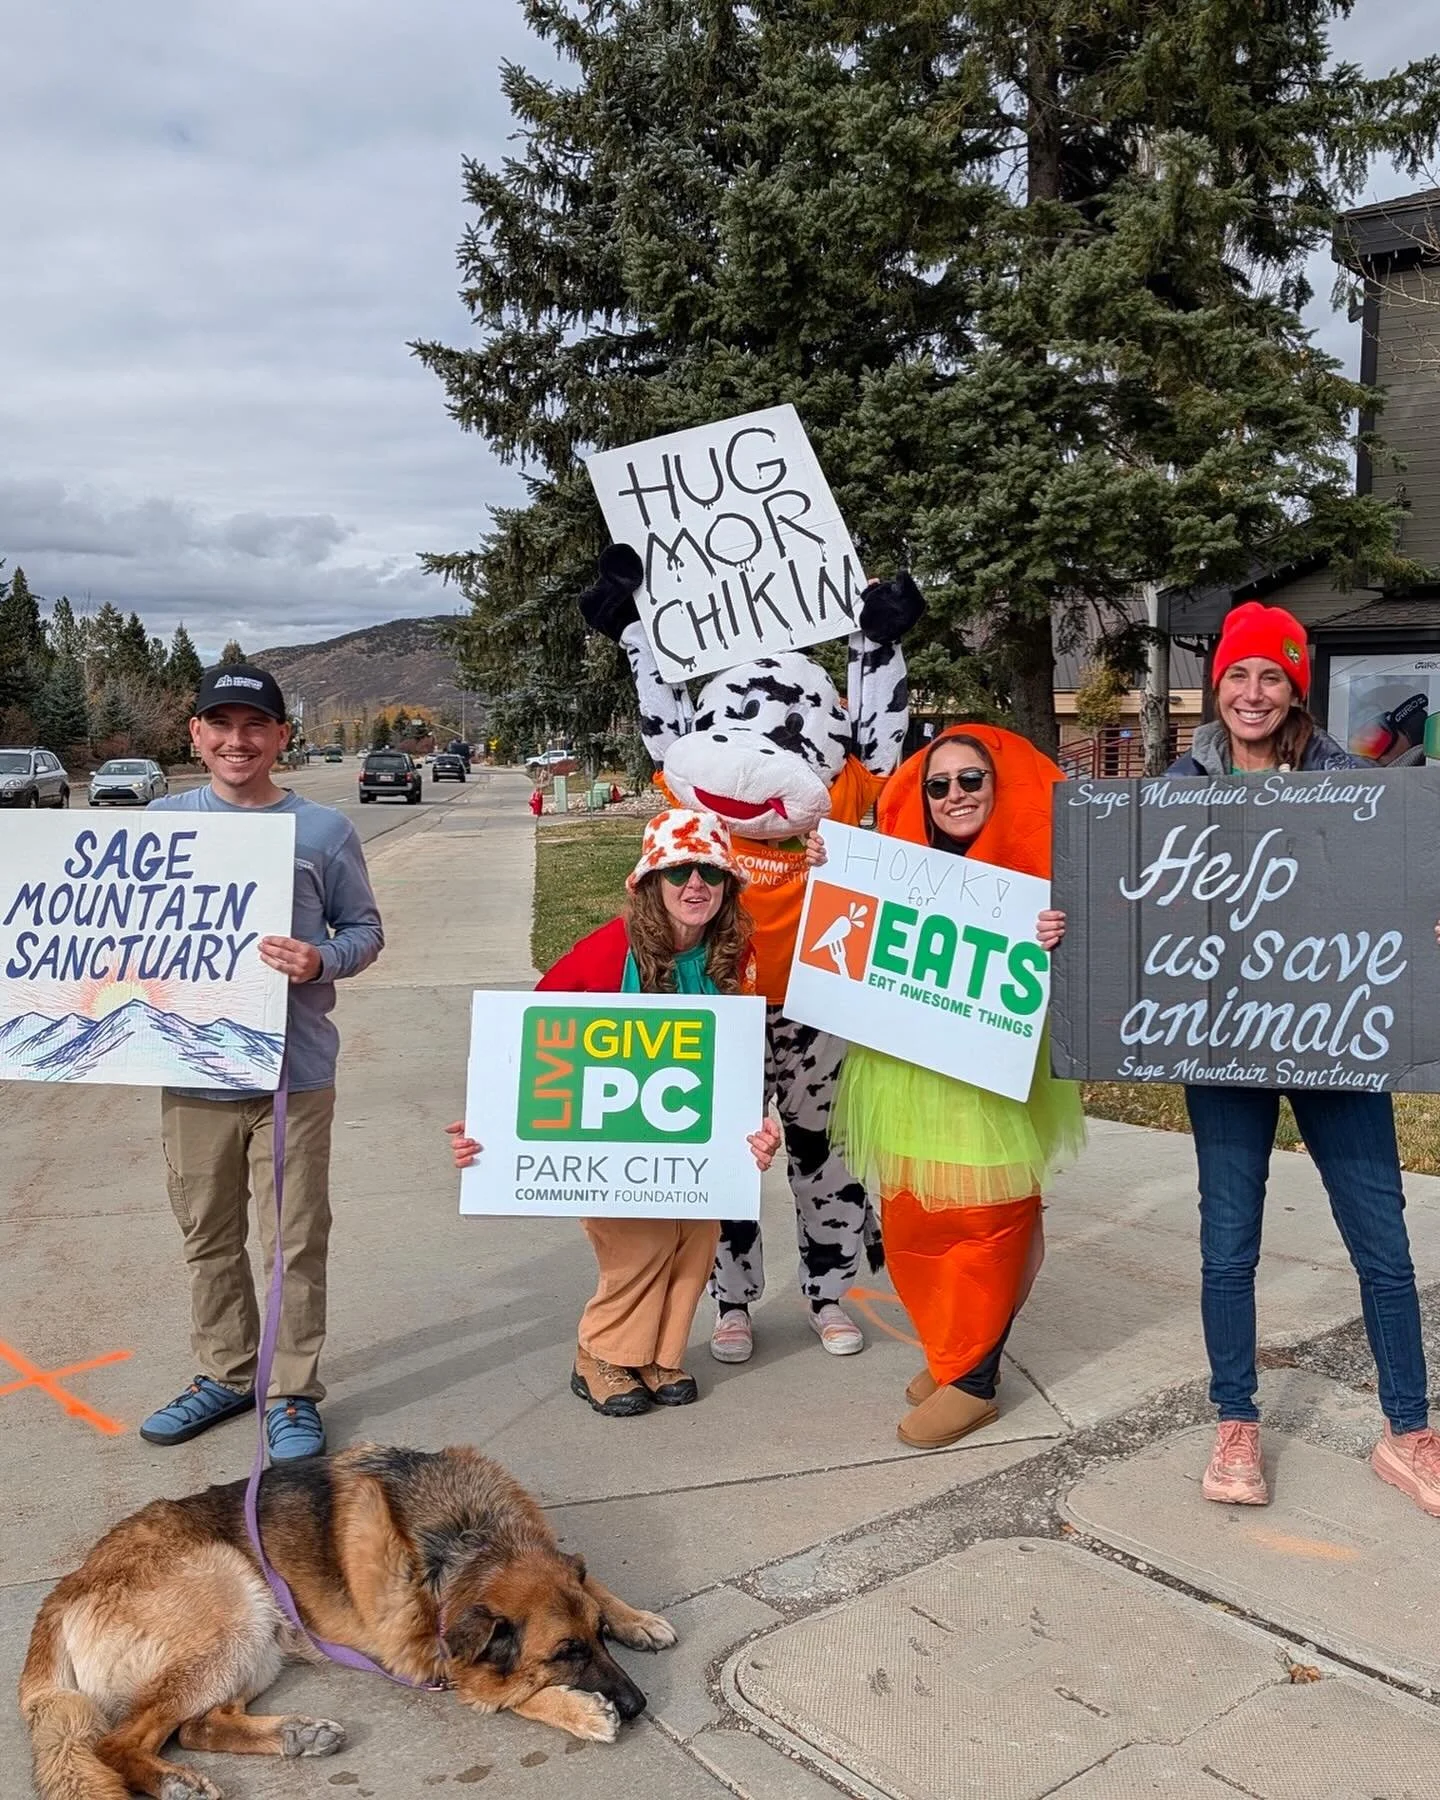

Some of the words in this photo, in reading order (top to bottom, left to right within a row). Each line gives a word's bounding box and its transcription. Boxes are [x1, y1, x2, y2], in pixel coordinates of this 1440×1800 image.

[618, 427, 787, 528] HUG
[646, 490, 827, 605] MOR
[652, 554, 862, 673] CHIKIN
[1068, 783, 1131, 819] Sage
[1139, 780, 1248, 808] Mountain
[1254, 775, 1386, 821] Sanctuary
[64, 829, 198, 881] SAGE
[761, 848, 786, 861] PARK
[788, 851, 806, 862] CIT
[844, 832, 1011, 918] HONK!
[1119, 824, 1299, 932] Help
[3, 881, 258, 932] MOUNTAIN
[907, 886, 937, 907] for
[5, 931, 259, 983] SANCTUARY
[871, 899, 1049, 1016] EATS
[1144, 933, 1226, 981] us
[1240, 930, 1408, 985] save
[867, 972, 897, 993] EAT
[899, 982, 972, 1018] AWESOME
[978, 1007, 1034, 1038] THINGS
[1119, 984, 1395, 1062] animals
[582, 1018, 703, 1061] GIVE
[532, 1017, 577, 1130] LIVE
[580, 1066, 703, 1132] PC
[1117, 1055, 1165, 1081] Sage
[1169, 1056, 1269, 1083] Mountain
[1275, 1058, 1389, 1093] Sanctuary
[514, 1187, 609, 1202] COMMUNITY
[614, 1189, 709, 1203] FOUNDATION
[515, 1154, 609, 1183] PARK
[623, 1156, 710, 1185] CITY
